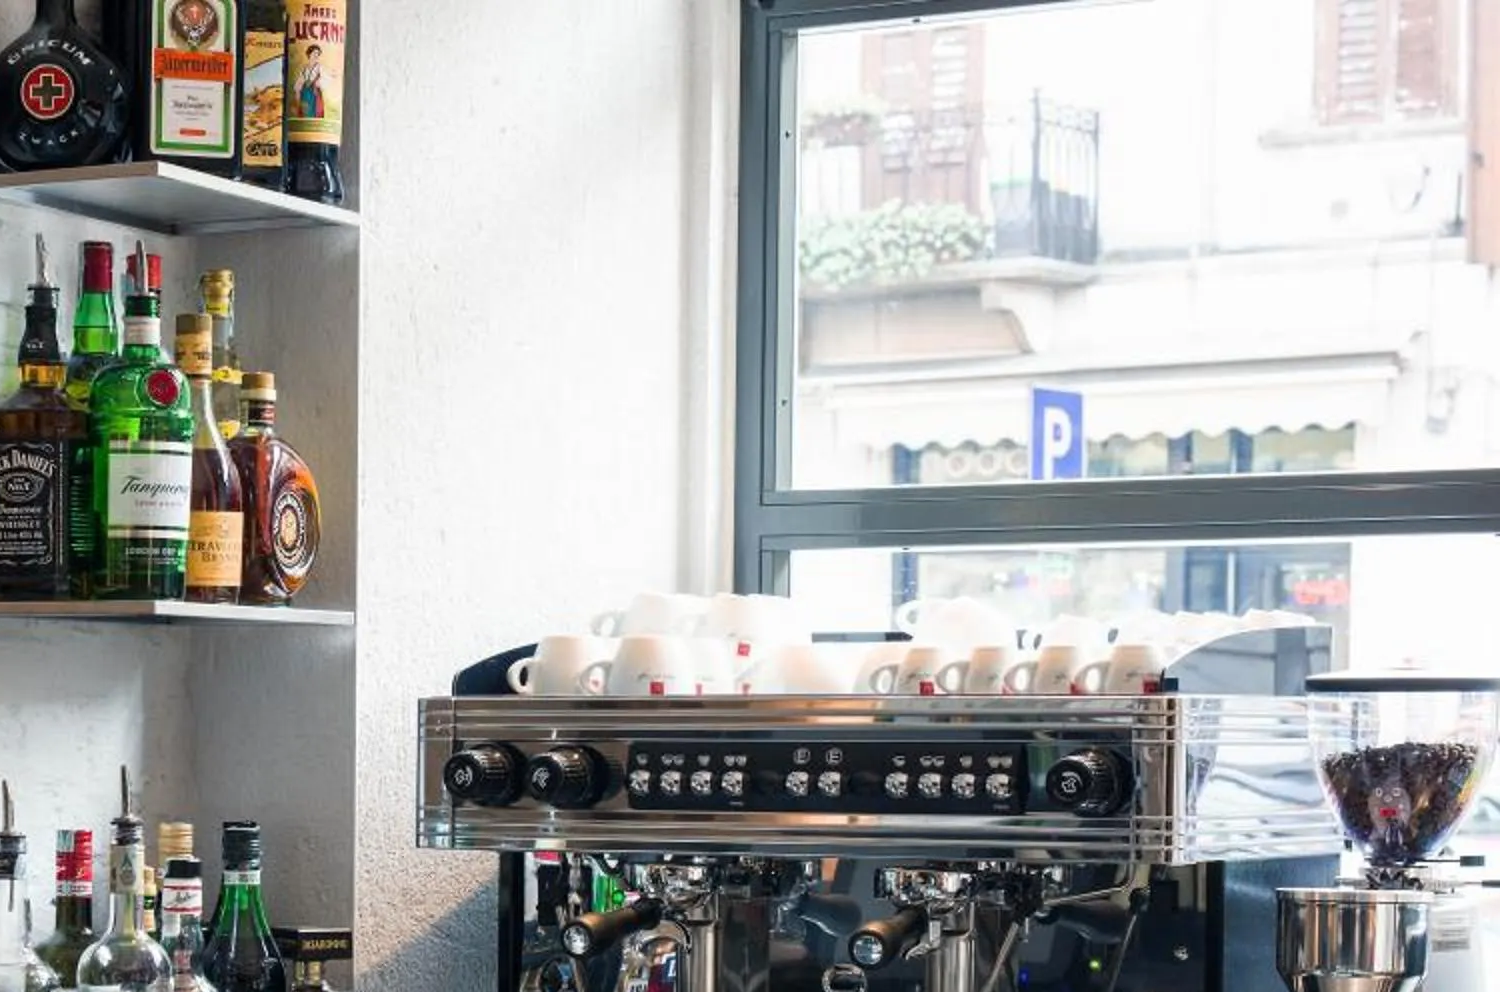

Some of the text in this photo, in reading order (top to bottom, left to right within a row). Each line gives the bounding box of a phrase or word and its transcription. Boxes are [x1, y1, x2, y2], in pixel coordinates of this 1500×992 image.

[289, 20, 345, 44] UCAN
[7, 39, 95, 65] UNICUM
[1043, 405, 1073, 480] P
[119, 475, 189, 498] Tanquer
